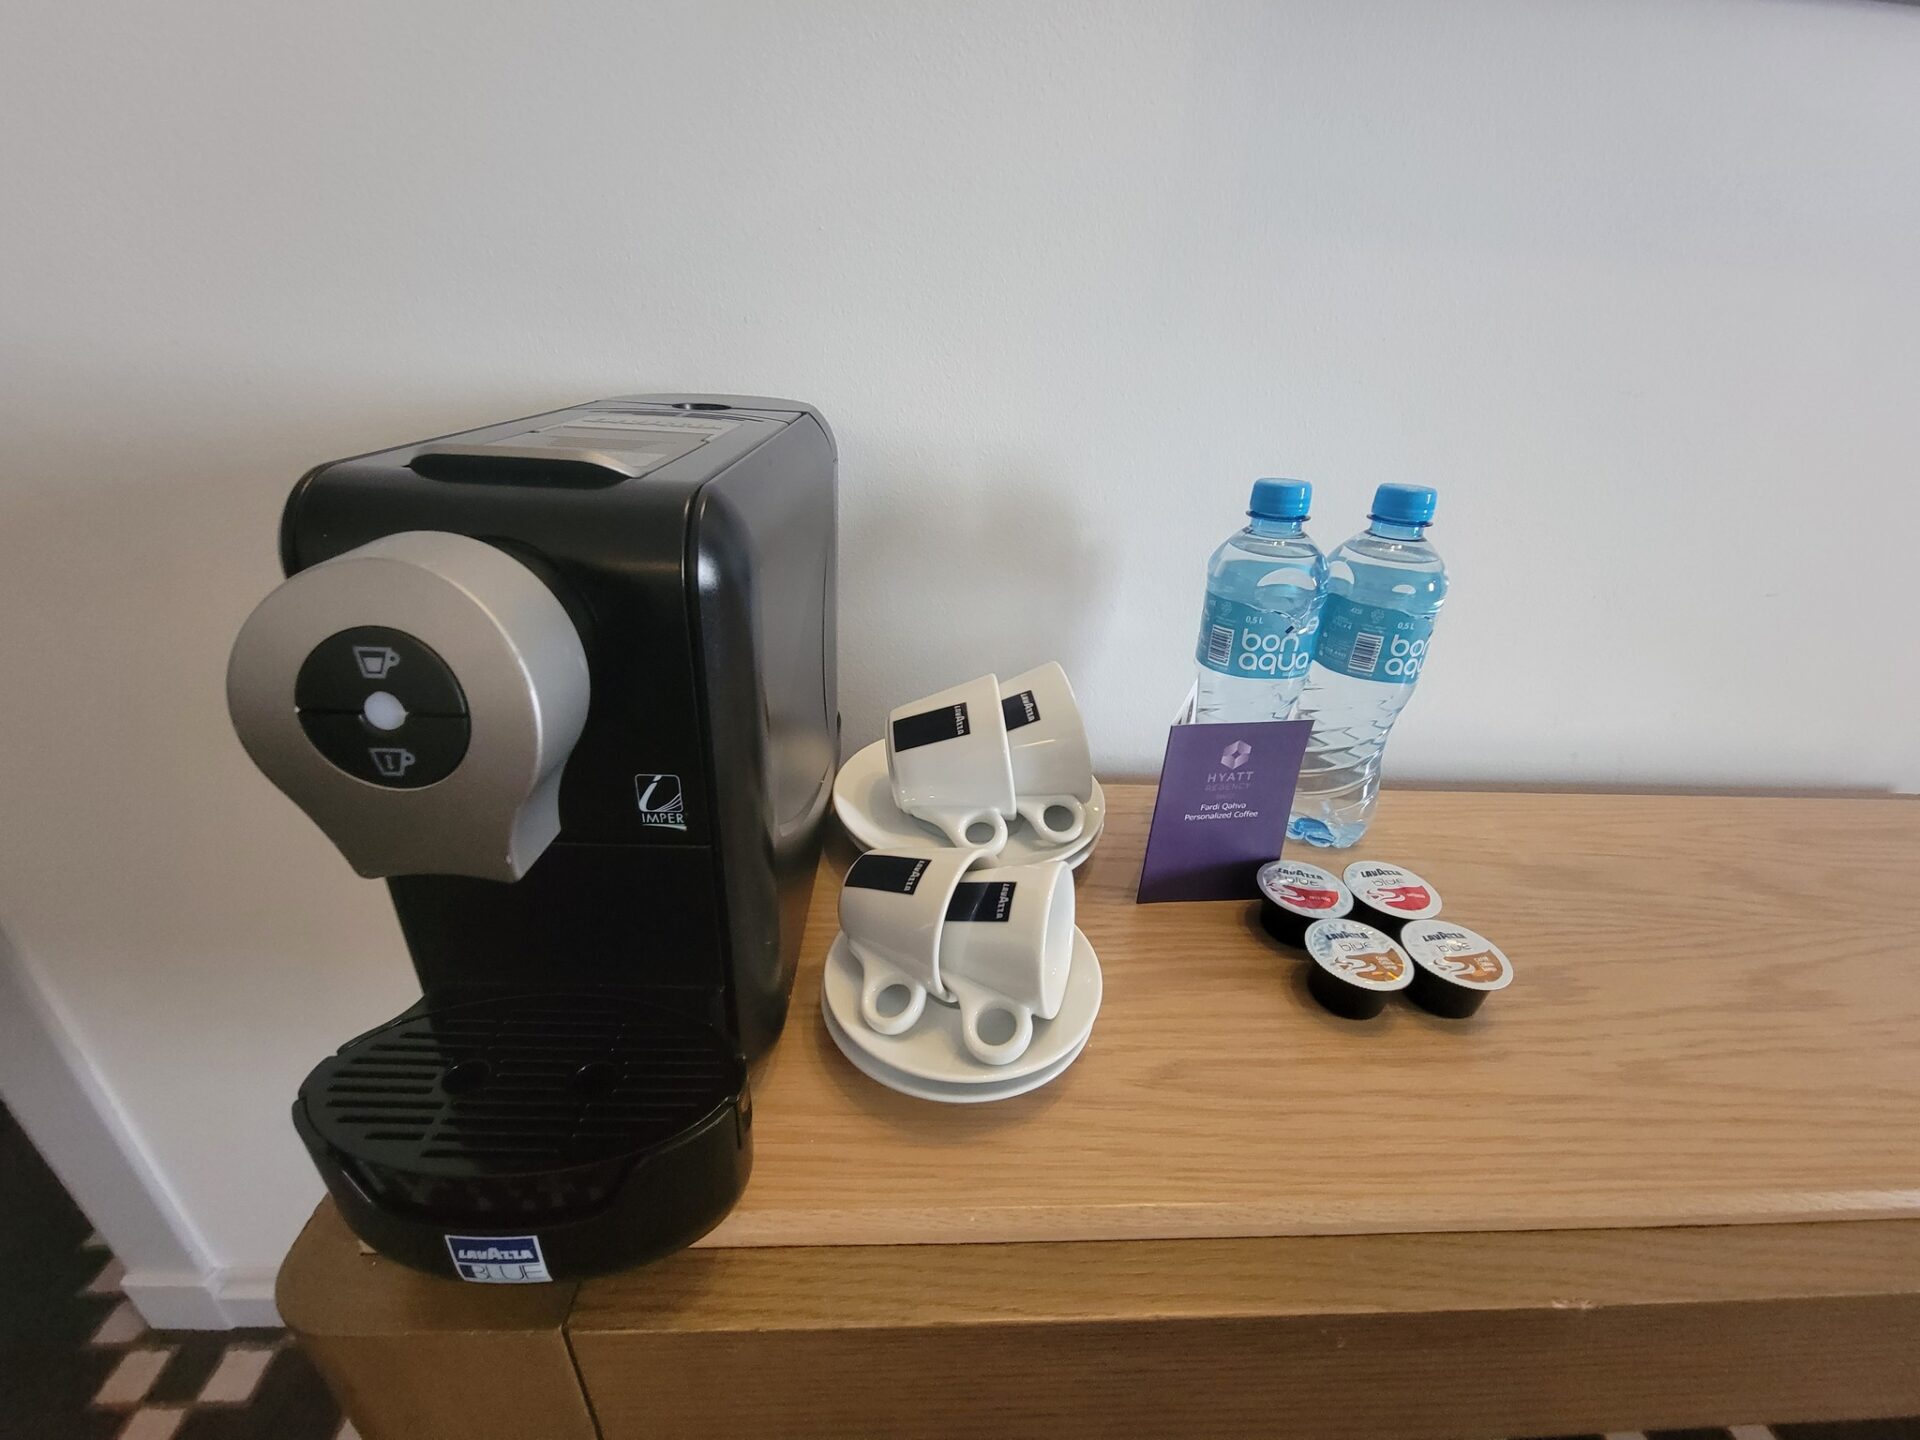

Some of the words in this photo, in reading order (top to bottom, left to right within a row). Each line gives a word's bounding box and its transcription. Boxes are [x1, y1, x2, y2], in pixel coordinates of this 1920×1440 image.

[1241, 628, 1299, 652] bon
[1238, 652, 1309, 675] aqua
[1207, 771, 1254, 783] HYATT
[641, 812, 685, 824] IMPER
[1184, 812, 1232, 821] Personalized
[1233, 810, 1259, 818] Coffee
[458, 1247, 534, 1260] LAVAZZA
